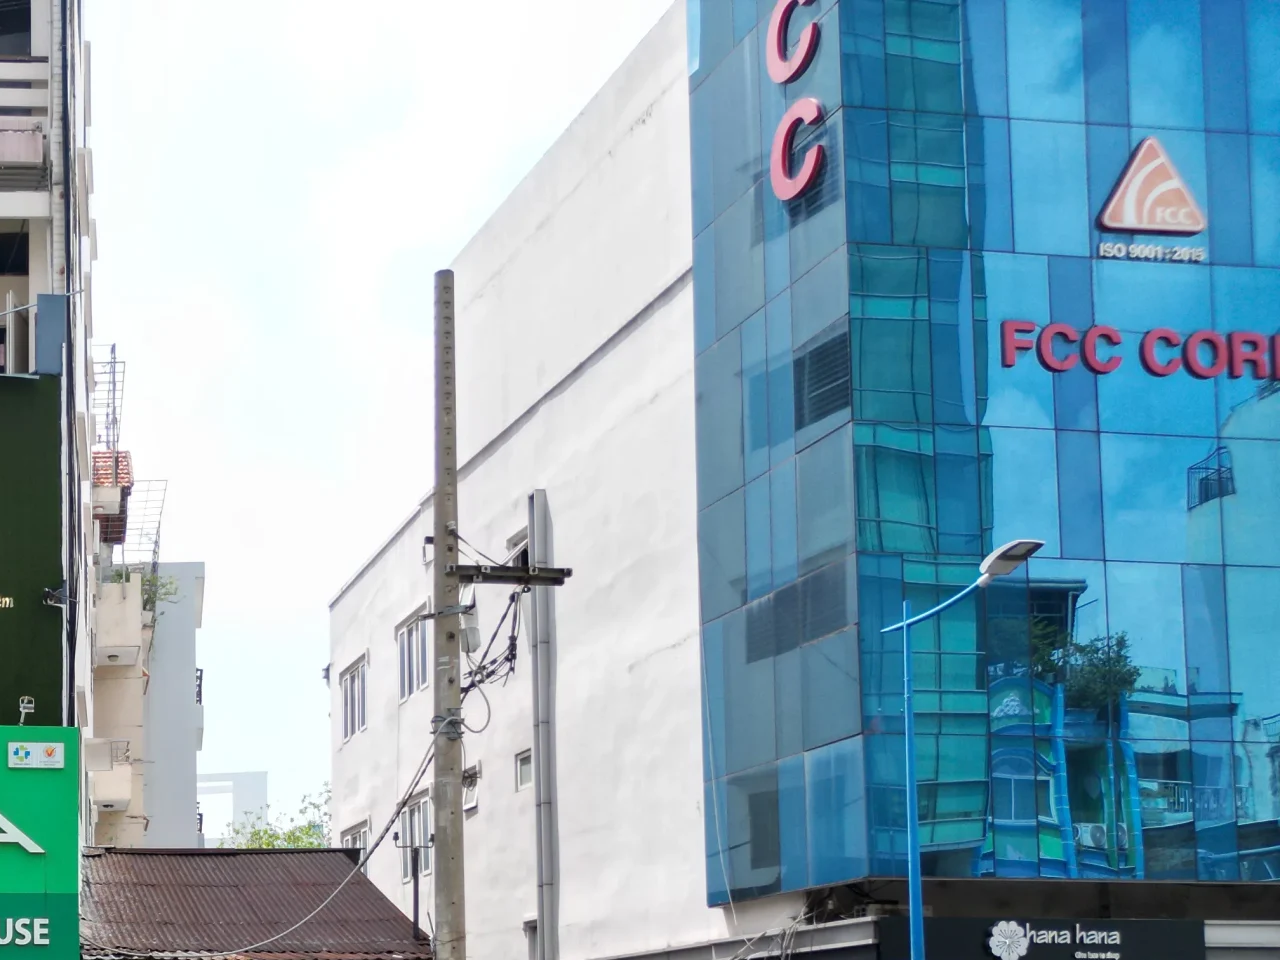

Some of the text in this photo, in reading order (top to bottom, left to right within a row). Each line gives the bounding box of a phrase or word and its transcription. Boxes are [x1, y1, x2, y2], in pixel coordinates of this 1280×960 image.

[1156, 207, 1192, 224] FCC
[1099, 243, 1125, 258] ISO
[1001, 320, 1122, 375] FCC
[1025, 923, 1120, 945] hana hana
